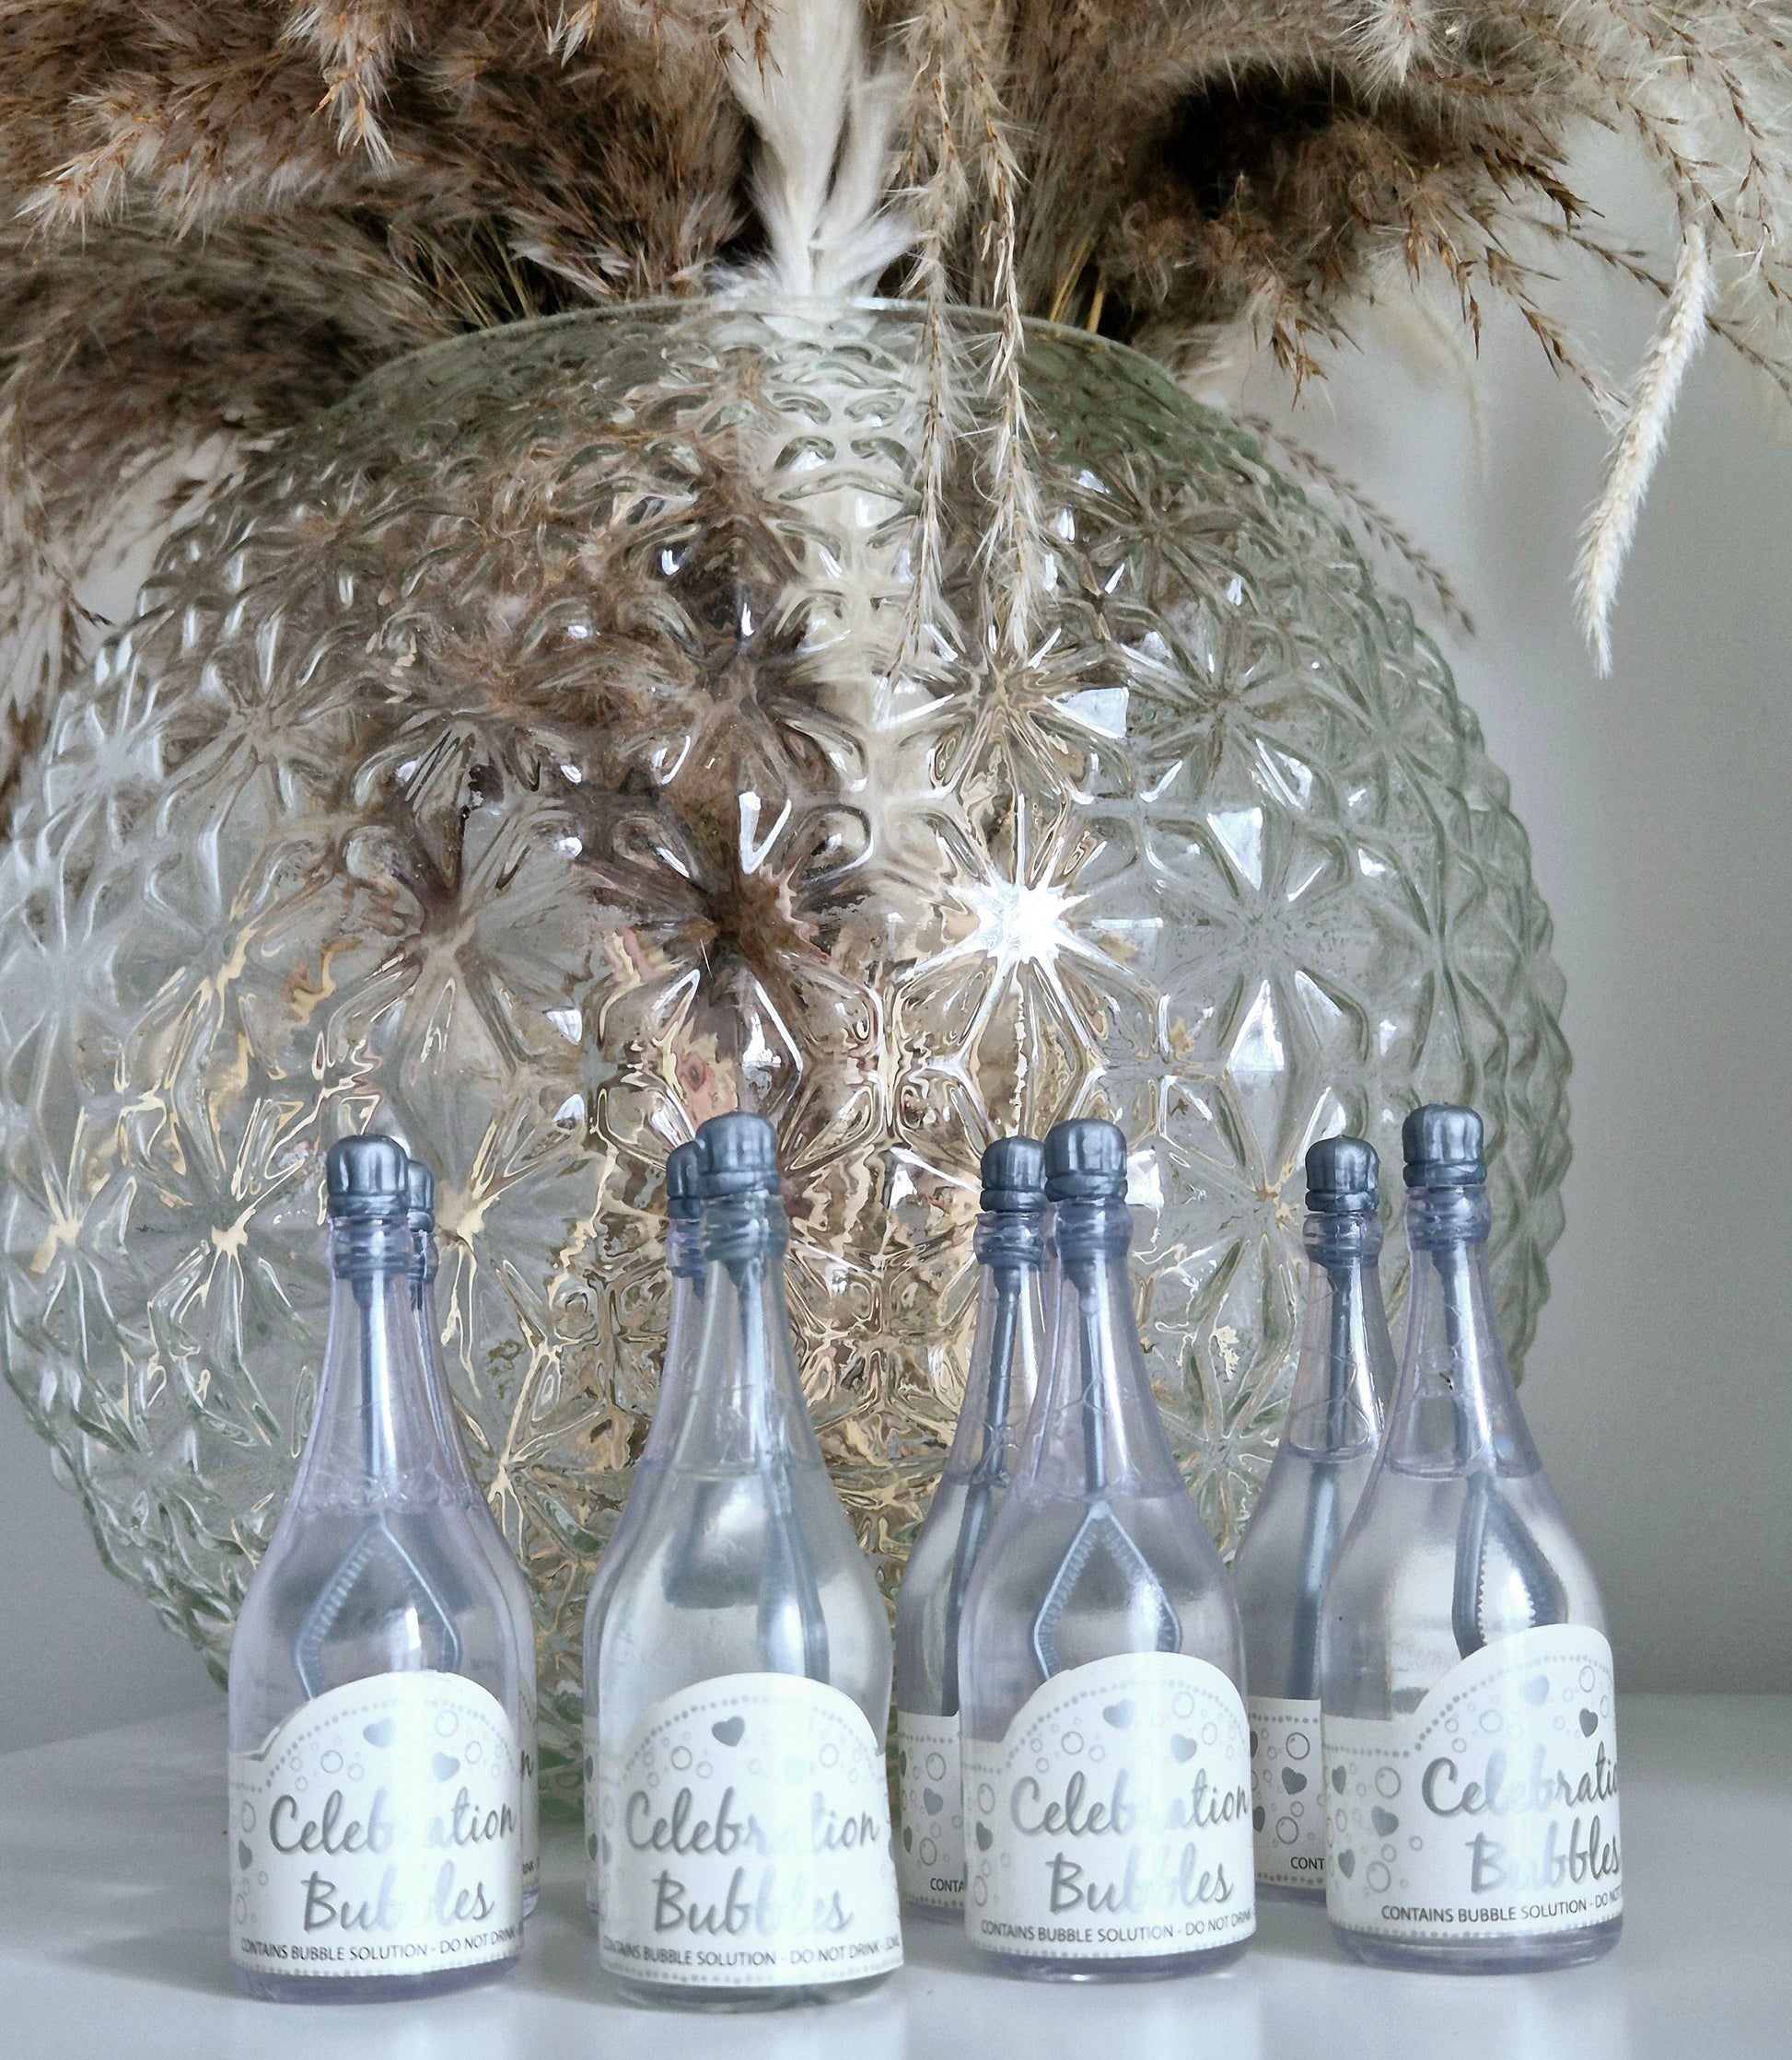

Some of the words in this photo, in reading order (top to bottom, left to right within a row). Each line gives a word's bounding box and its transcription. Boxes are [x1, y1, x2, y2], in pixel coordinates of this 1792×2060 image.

[1381, 1903, 1453, 1923] CONTAINS
[1458, 1905, 1517, 1923] BUBBLE
[1520, 1899, 1587, 1920] SOLUTION
[1595, 1892, 1608, 1908] DO
[981, 1919, 1035, 1941] CONTAINS
[1038, 1927, 1093, 1943] BUBBLE
[1097, 1926, 1174, 1942] SOLUTION
[1185, 1920, 1204, 1936] DO
[1207, 1915, 1228, 1932] NOT
[291, 1944, 345, 1961] BUBBLE
[349, 1943, 427, 1961] SOLUTION
[440, 1938, 461, 1954] DO
[464, 1933, 487, 1949] NOT
[644, 1946, 693, 1965] BUBBLE
[697, 1950, 776, 1967] SOLUTION
[790, 1949, 814, 1964] DO
[818, 1945, 845, 1961] NOT
